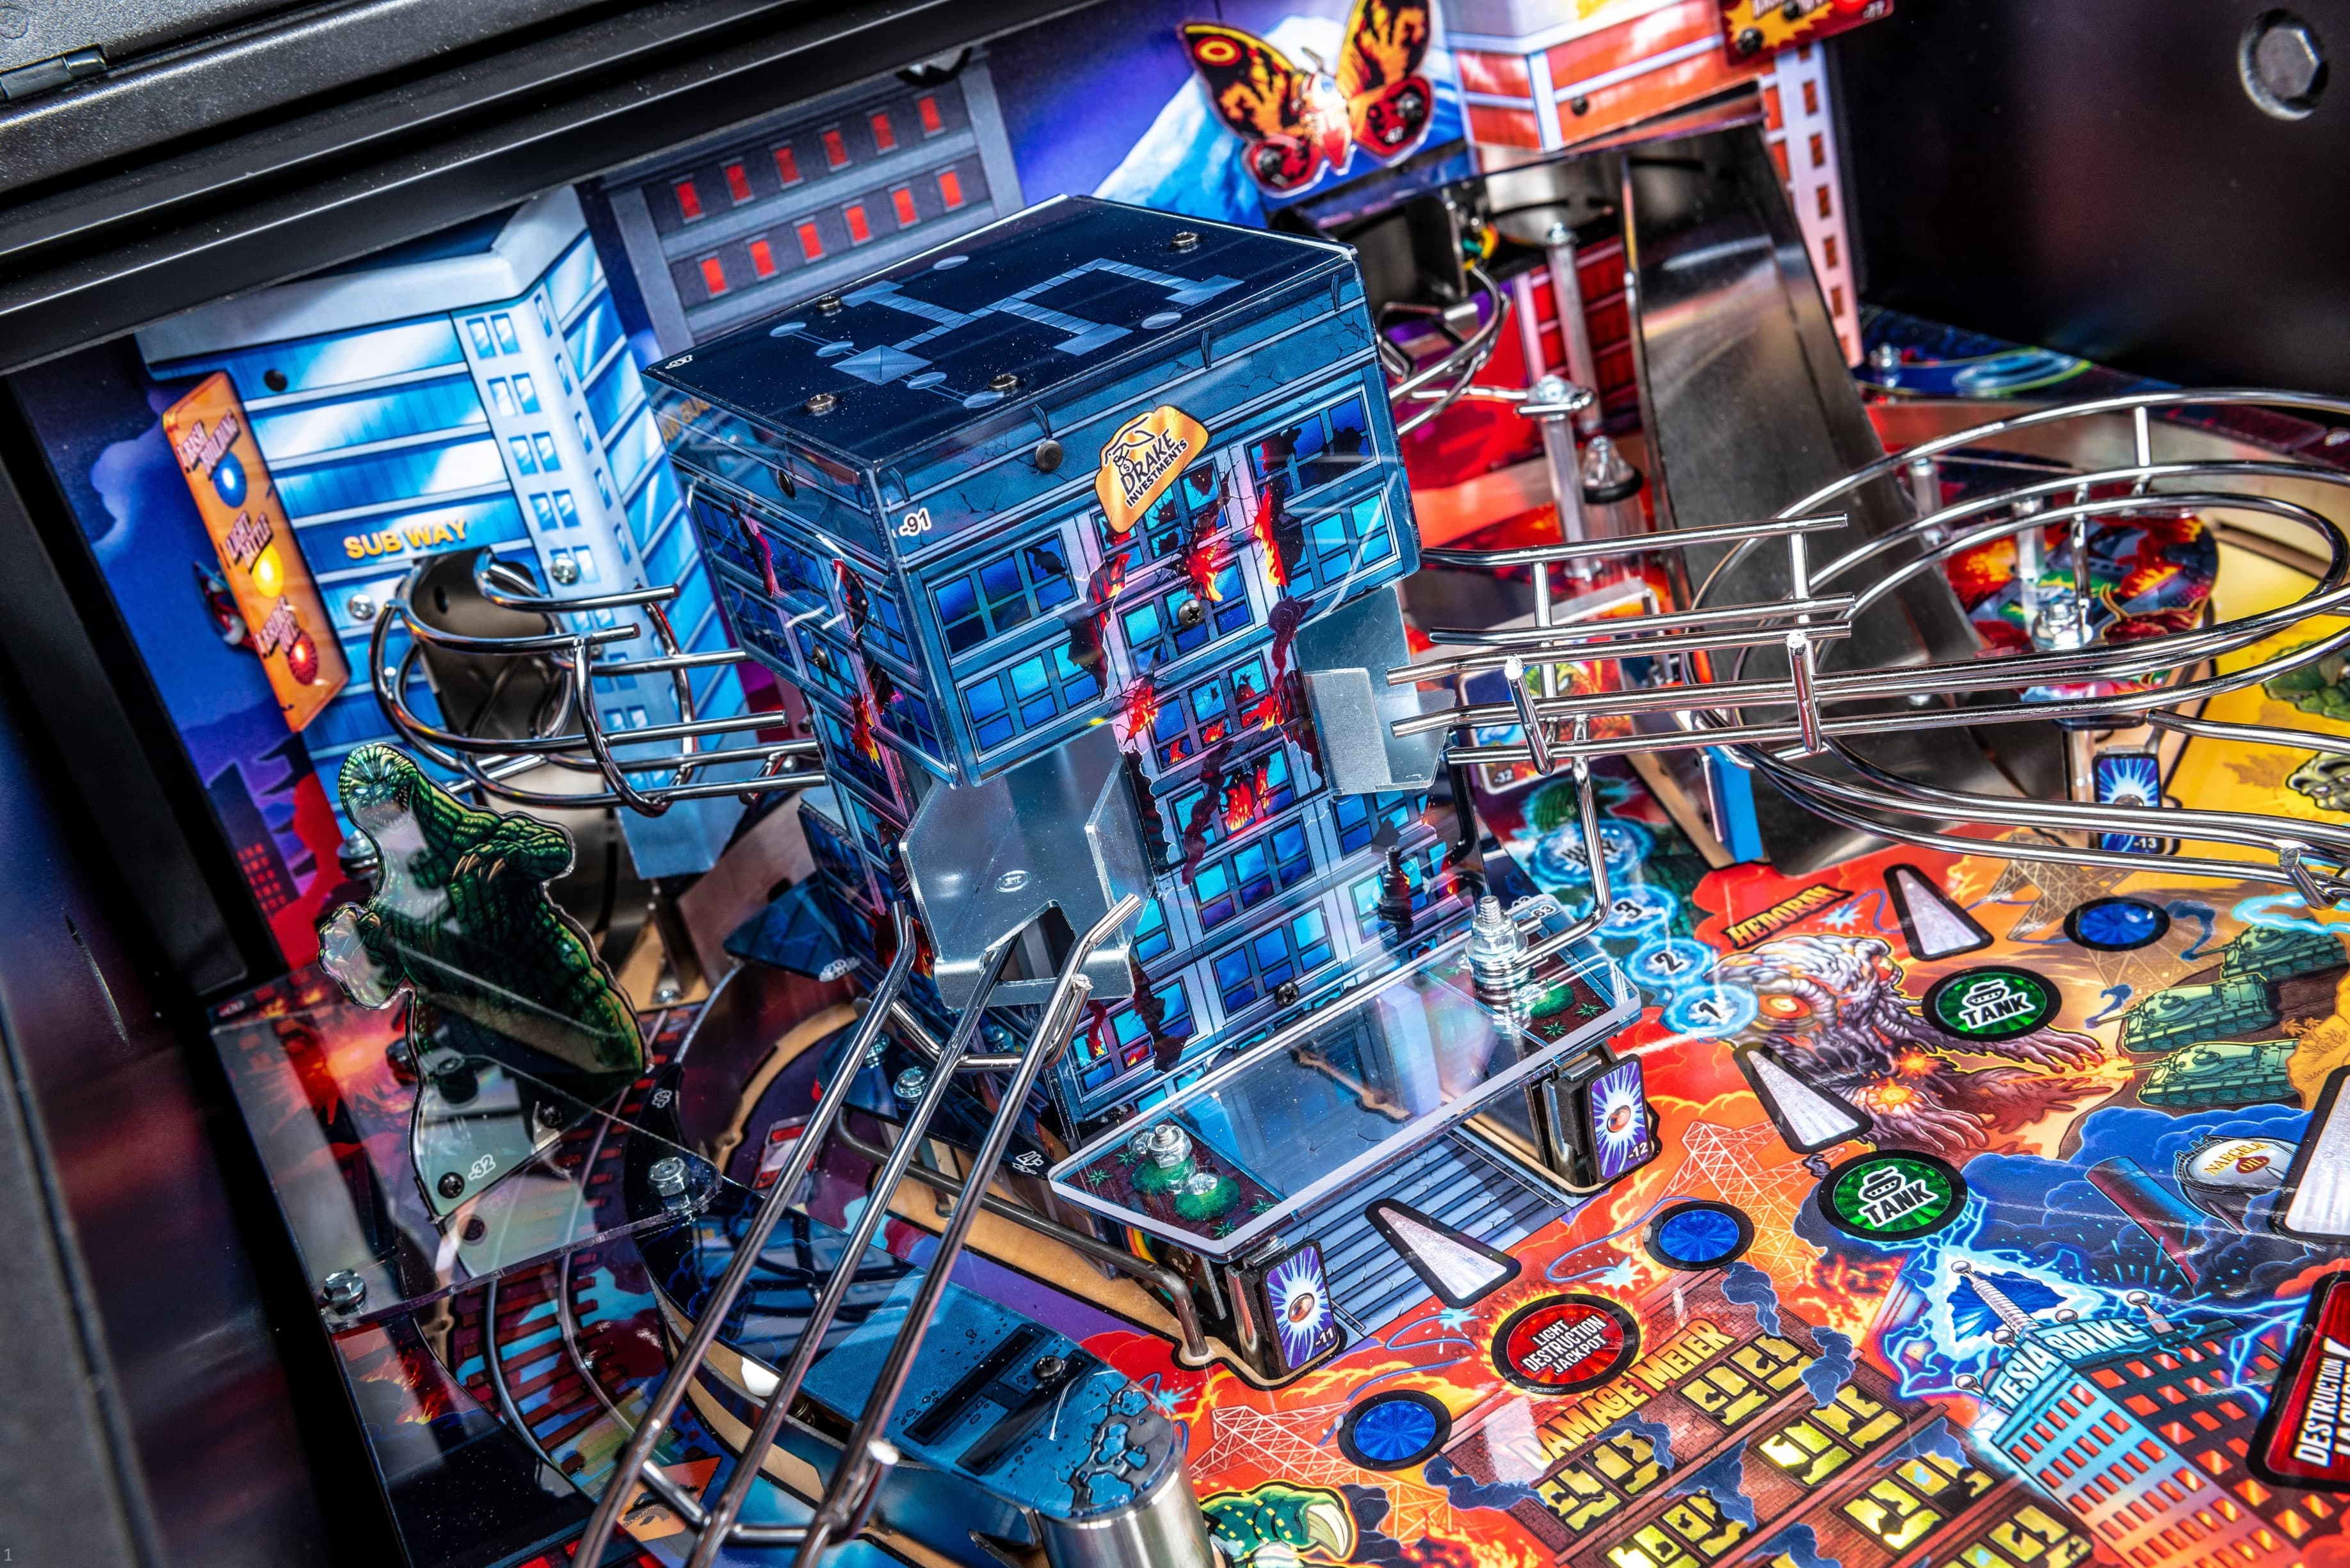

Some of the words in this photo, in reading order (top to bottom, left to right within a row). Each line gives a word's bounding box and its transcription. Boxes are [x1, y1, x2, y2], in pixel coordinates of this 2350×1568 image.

[1120, 428, 1176, 497] DRAKE
[1125, 438, 1189, 508] INVESTMENTS
[343, 529, 403, 559] SUB
[403, 517, 467, 548] WAY
[901, 509, 930, 534] -91
[2133, 837, 2157, 849] -13
[1615, 900, 1642, 919] 3
[1725, 884, 1844, 945] HEDORAH
[1654, 952, 1684, 972] 2
[1698, 1001, 1722, 1020] 1
[1961, 993, 2032, 1027] TANK
[469, 1155, 495, 1180] -32
[1629, 1142, 1648, 1158] -12
[2203, 1141, 2269, 1176] NAEGELE
[2239, 1158, 2267, 1171] OIL
[1862, 1180, 1936, 1225] TANK
[1316, 1327, 1333, 1345] -11
[1522, 1315, 1608, 1373] DESTRUCTION
[1532, 1320, 1570, 1347] LIGHT
[2032, 1317, 2153, 1361] STRIKE
[1552, 1334, 1607, 1374] JACKPOT
[1986, 1340, 2064, 1410] TESLA
[1506, 1375, 1652, 1472] DAMAGE
[1629, 1318, 1737, 1393] METER
[2294, 1357, 2344, 1468] DESTRUCTION
